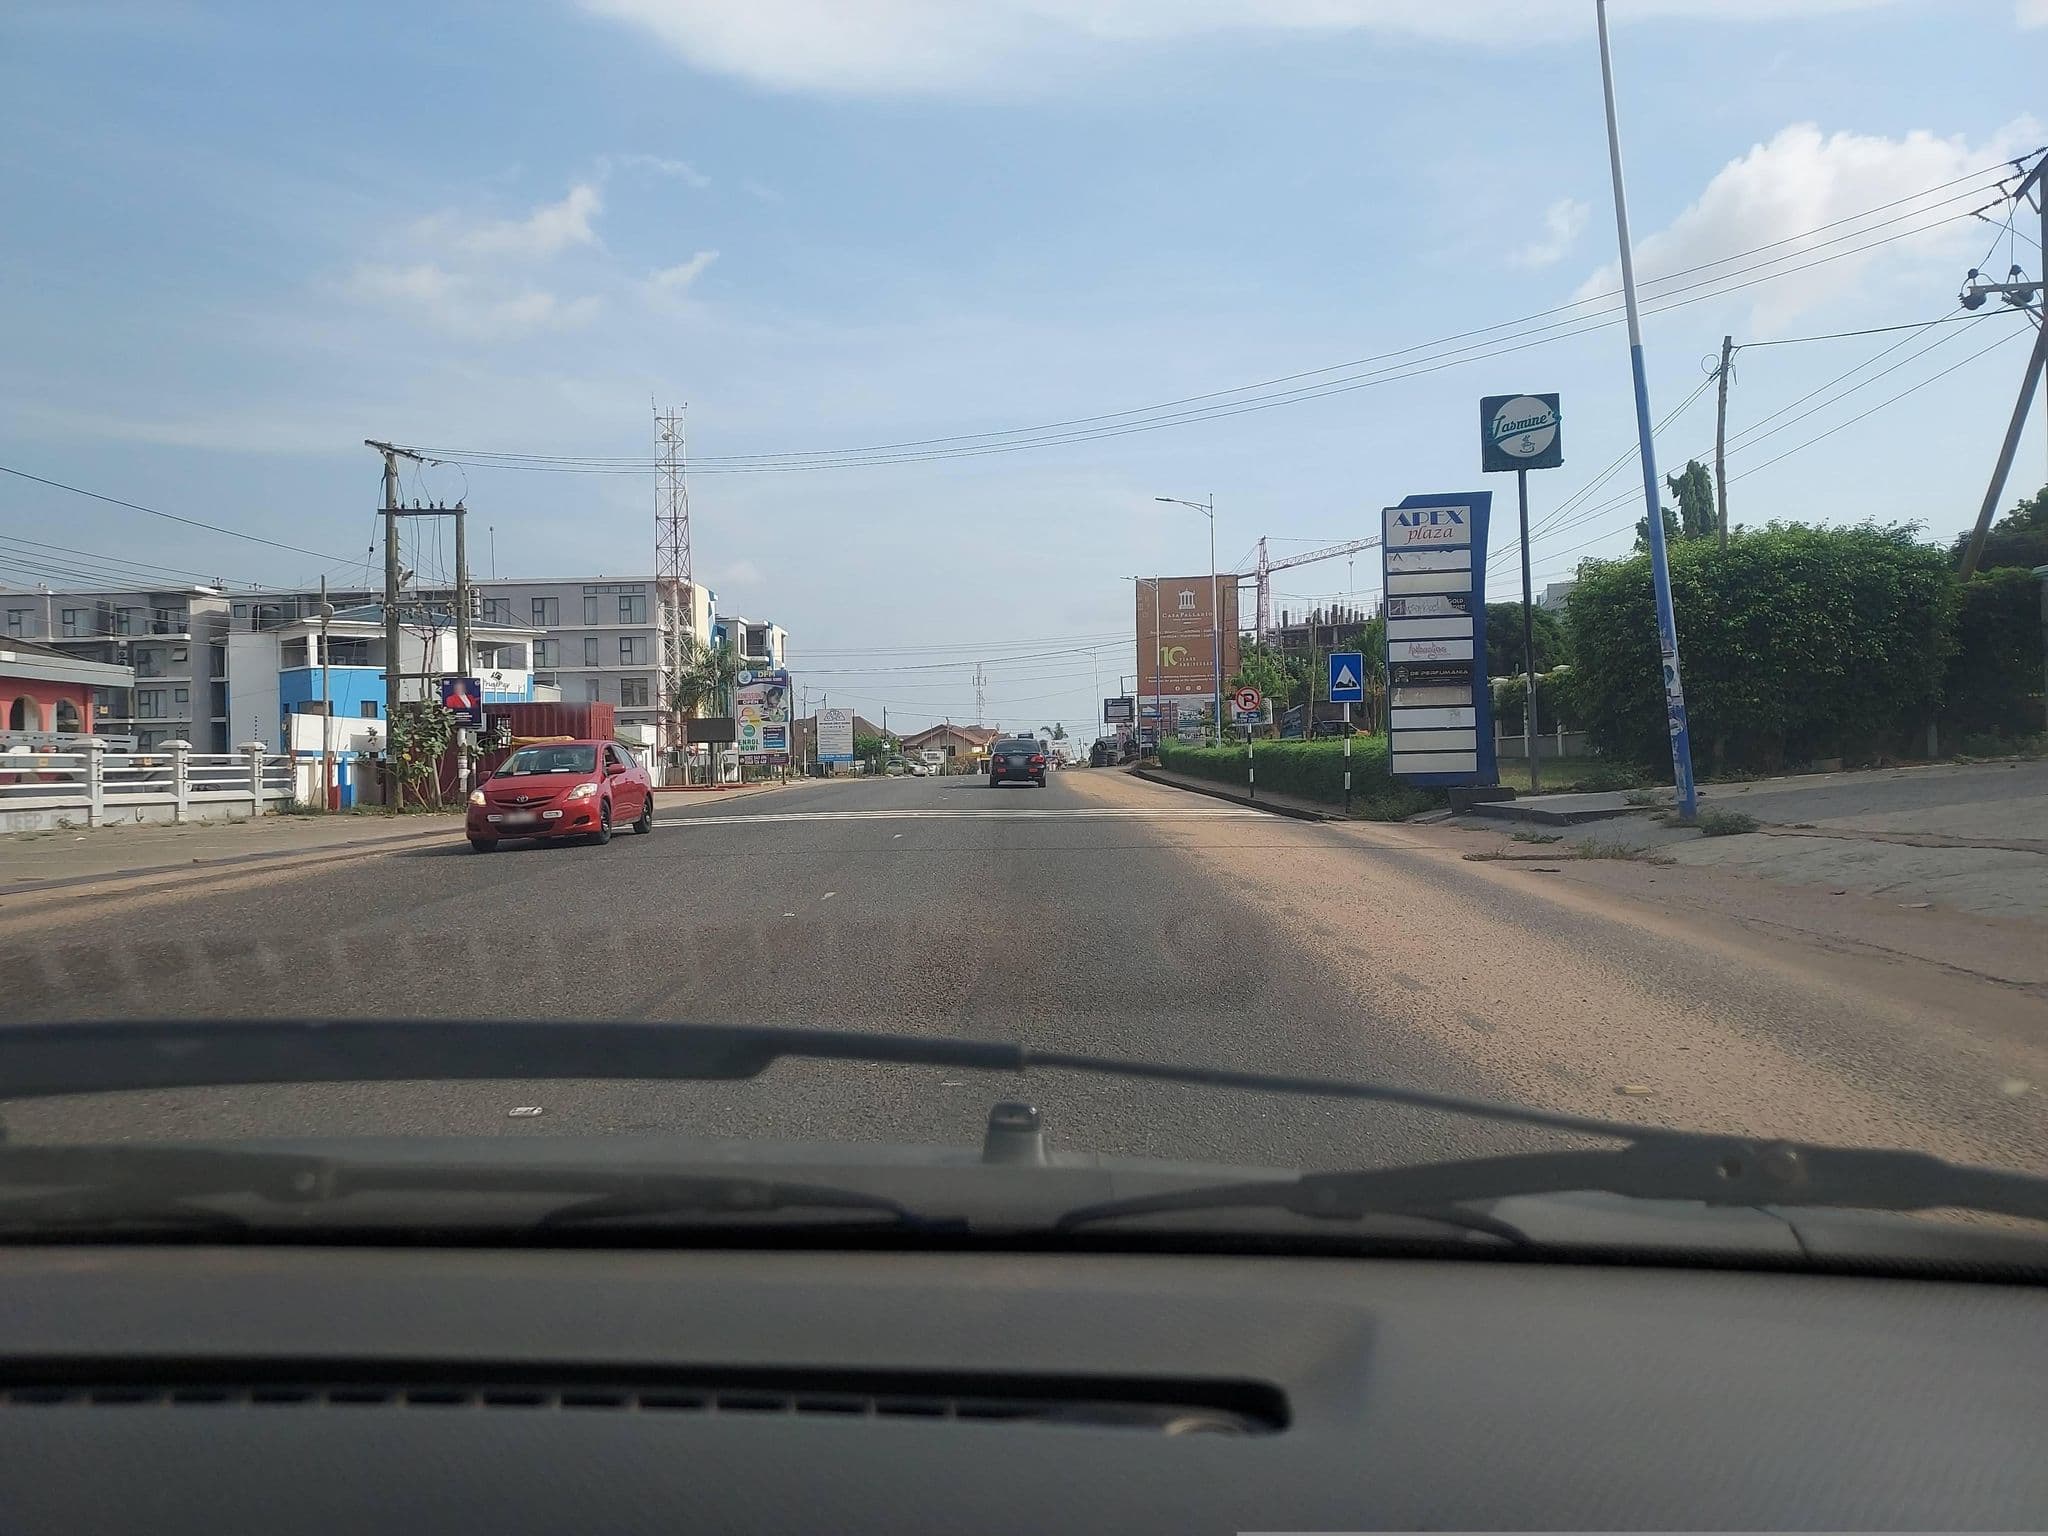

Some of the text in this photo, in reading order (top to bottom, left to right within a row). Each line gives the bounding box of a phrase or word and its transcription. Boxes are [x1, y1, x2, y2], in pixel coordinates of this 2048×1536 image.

[1489, 409, 1562, 439] Jasmine's
[1393, 509, 1464, 528] APEX
[1405, 525, 1457, 545] plaza
[1243, 693, 1255, 706] P
